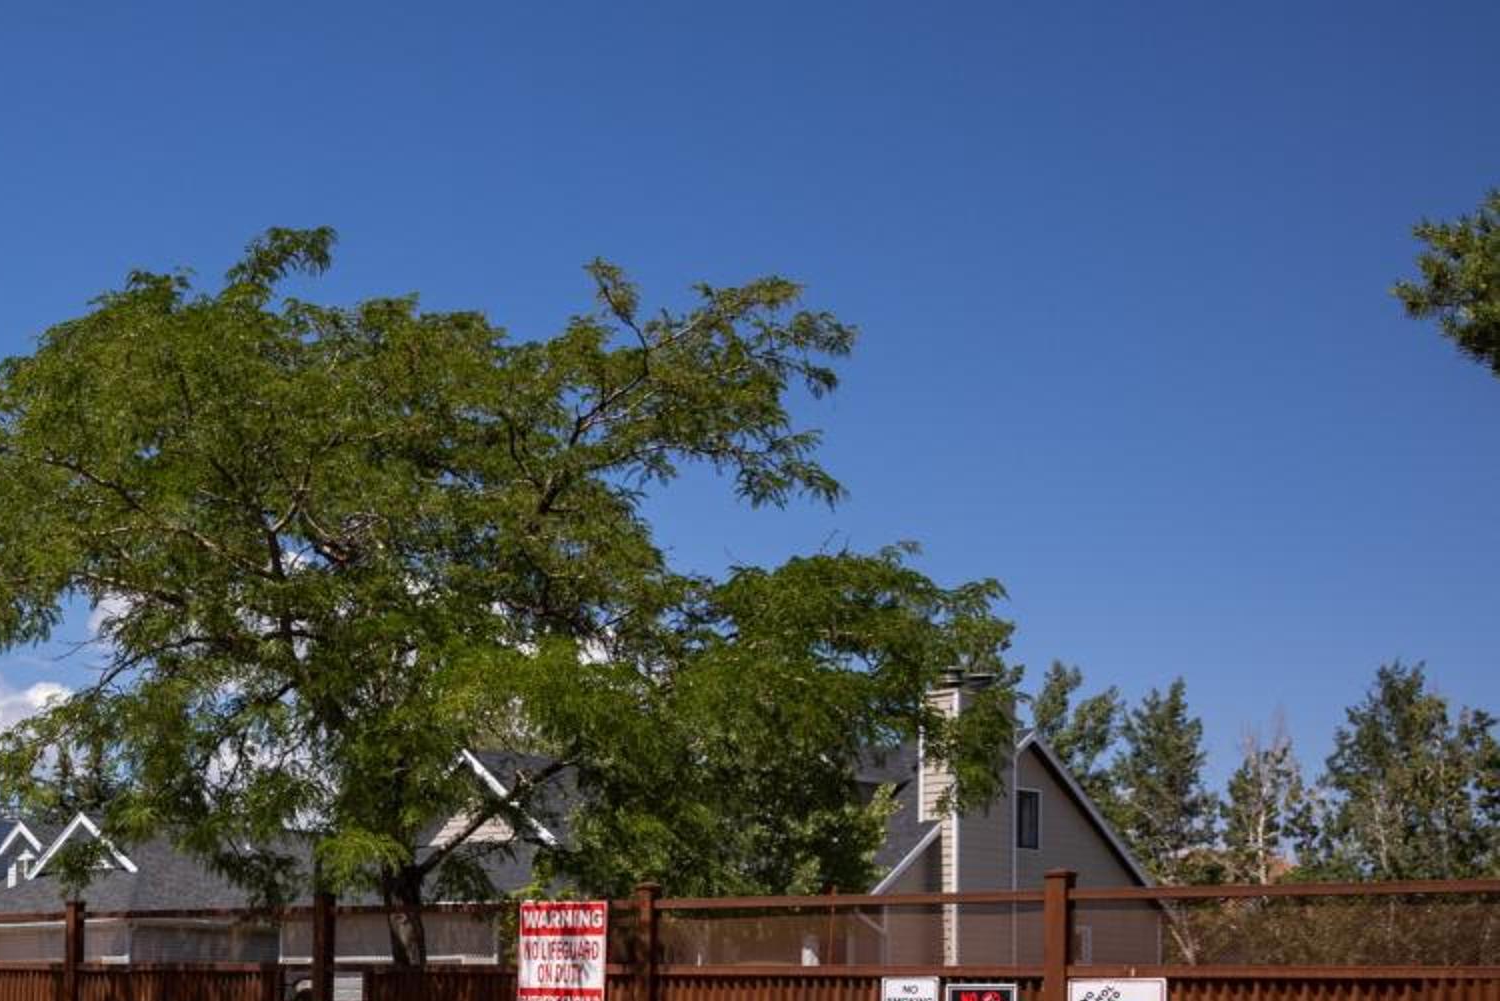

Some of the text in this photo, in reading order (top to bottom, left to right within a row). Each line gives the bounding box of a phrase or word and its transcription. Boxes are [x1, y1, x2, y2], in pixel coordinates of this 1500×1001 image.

[523, 909, 603, 929] WARNING
[523, 940, 599, 961] NO LIFEGUARD
[537, 963, 589, 983] ON DUTY
[902, 985, 919, 994] NO
